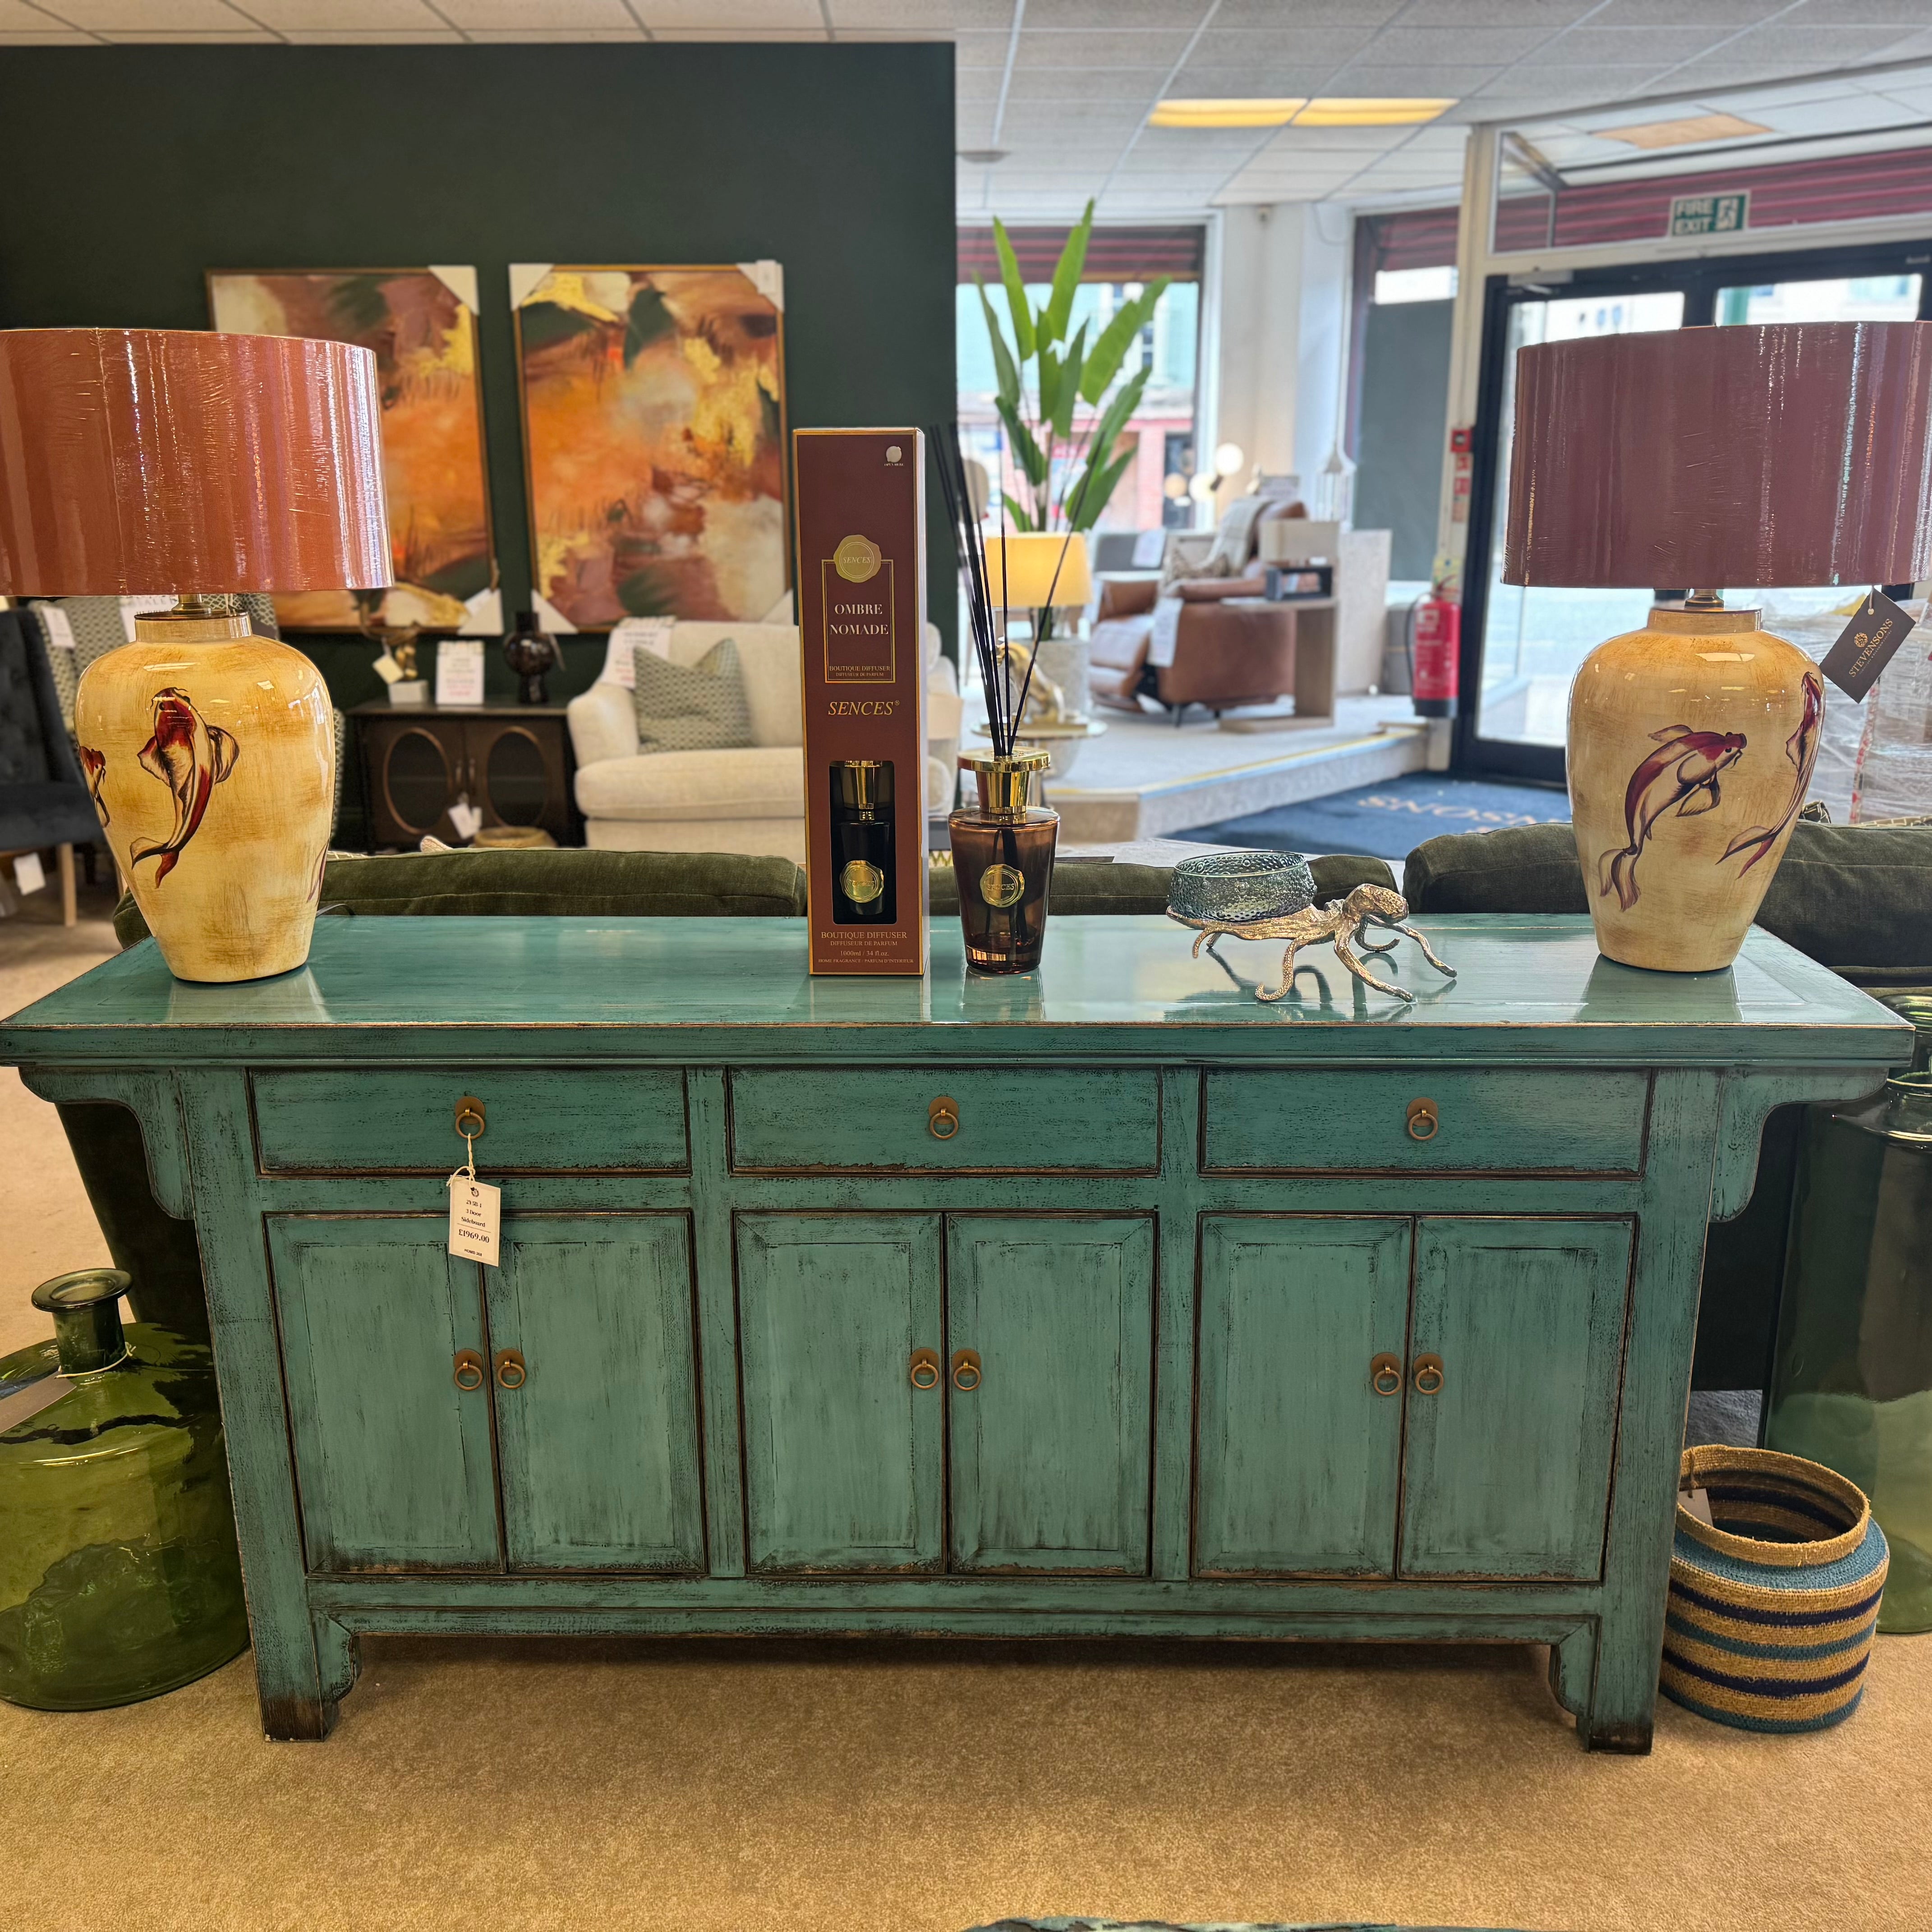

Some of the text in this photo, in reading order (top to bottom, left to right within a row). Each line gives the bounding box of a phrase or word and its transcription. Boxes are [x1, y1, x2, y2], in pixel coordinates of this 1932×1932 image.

[1676, 199, 1713, 216] FIRE
[1675, 217, 1712, 234] EXIT
[834, 604, 883, 615] OMBRE
[830, 624, 888, 635] NOMADE
[1849, 618, 1893, 677] STEVENSONS
[821, 932, 865, 940] BOUTIQUE
[461, 1216, 485, 1227] Sideboard
[459, 1229, 489, 1243] £1969.00
